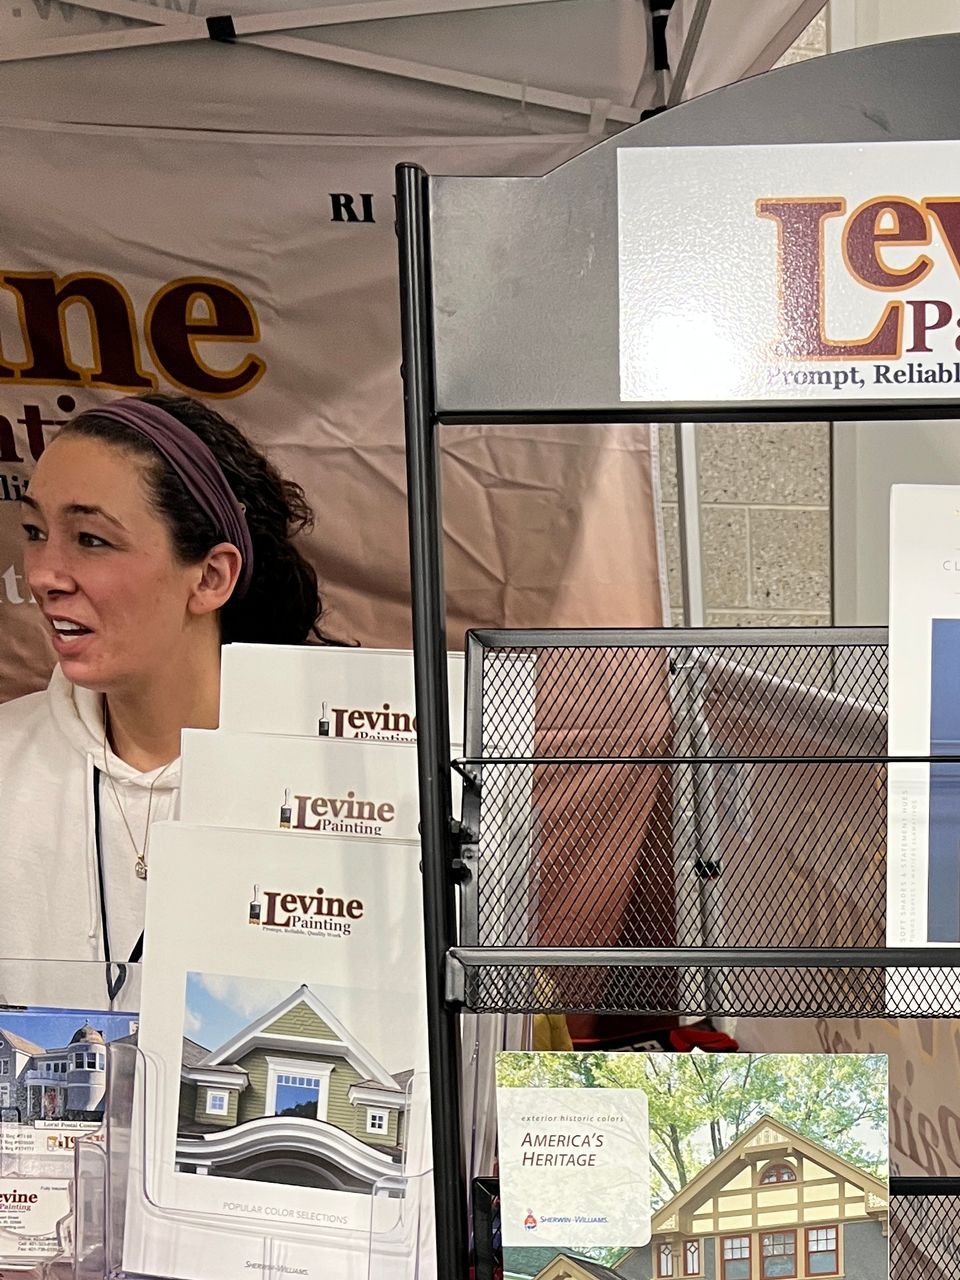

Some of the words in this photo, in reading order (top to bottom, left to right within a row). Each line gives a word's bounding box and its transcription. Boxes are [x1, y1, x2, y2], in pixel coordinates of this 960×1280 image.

[331, 703, 417, 738] Levin
[292, 791, 395, 831] Levine
[321, 819, 383, 836] Painting
[262, 887, 364, 927] Levine
[291, 914, 352, 936] Painting
[521, 1115, 557, 1123] exterior
[561, 1114, 593, 1123] historic
[597, 1115, 625, 1123] colors
[521, 1151, 597, 1168] HERITAGE
[223, 1201, 262, 1214] POPULAR
[264, 1206, 295, 1219] COLOR
[296, 1211, 348, 1225] SELECTIONS
